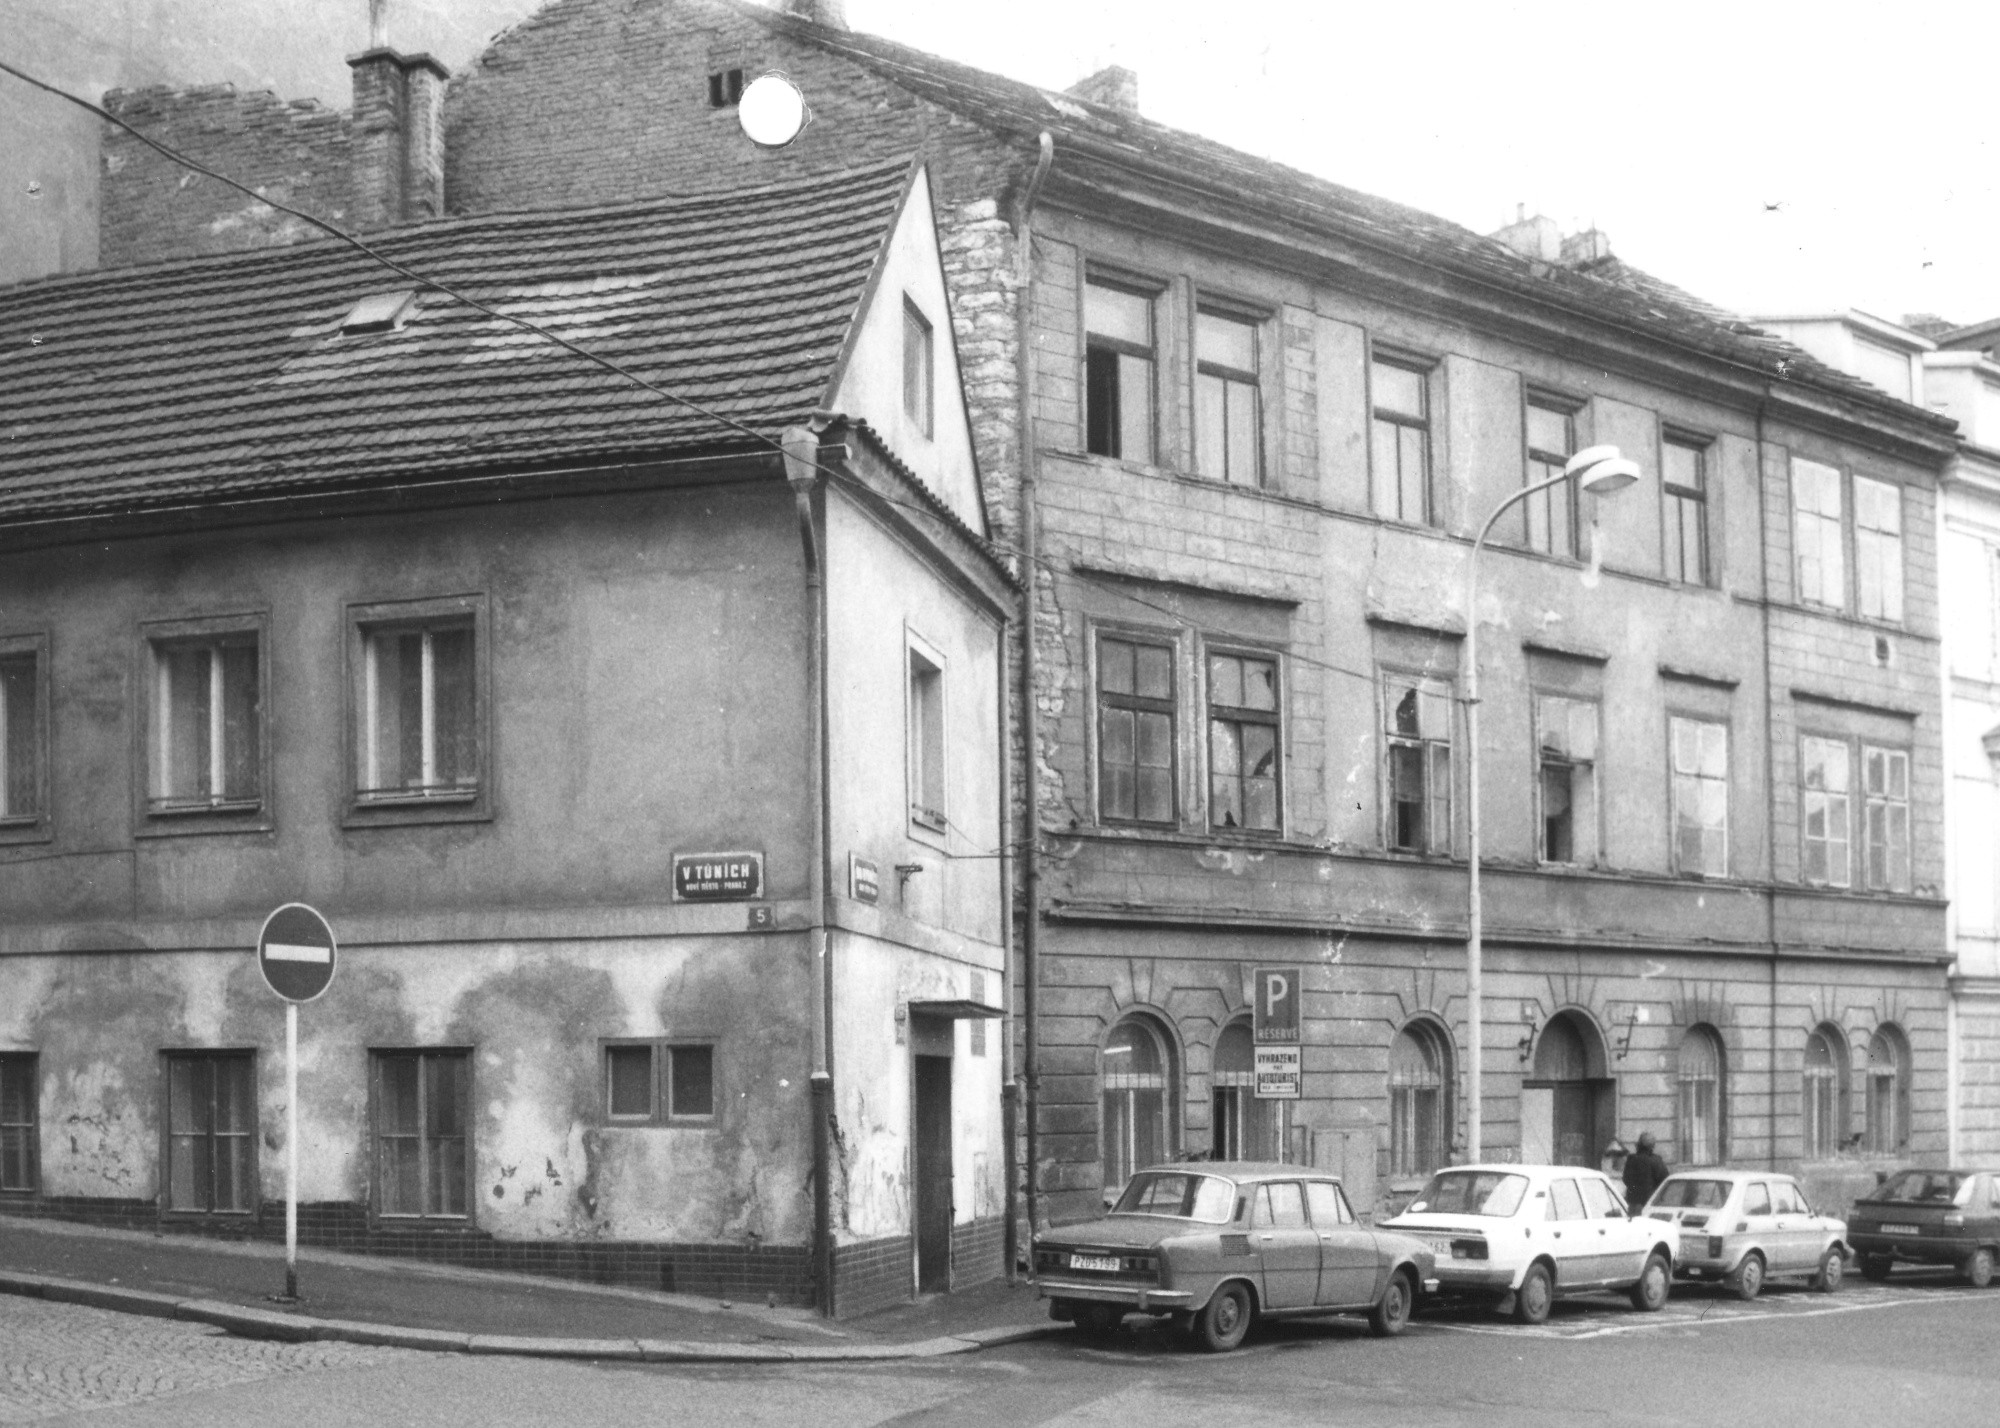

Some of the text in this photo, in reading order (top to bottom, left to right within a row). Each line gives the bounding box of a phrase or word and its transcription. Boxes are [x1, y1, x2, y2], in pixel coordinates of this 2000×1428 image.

[683, 866, 690, 880] V
[757, 909, 766, 923] 5
[1267, 974, 1288, 1016] P
